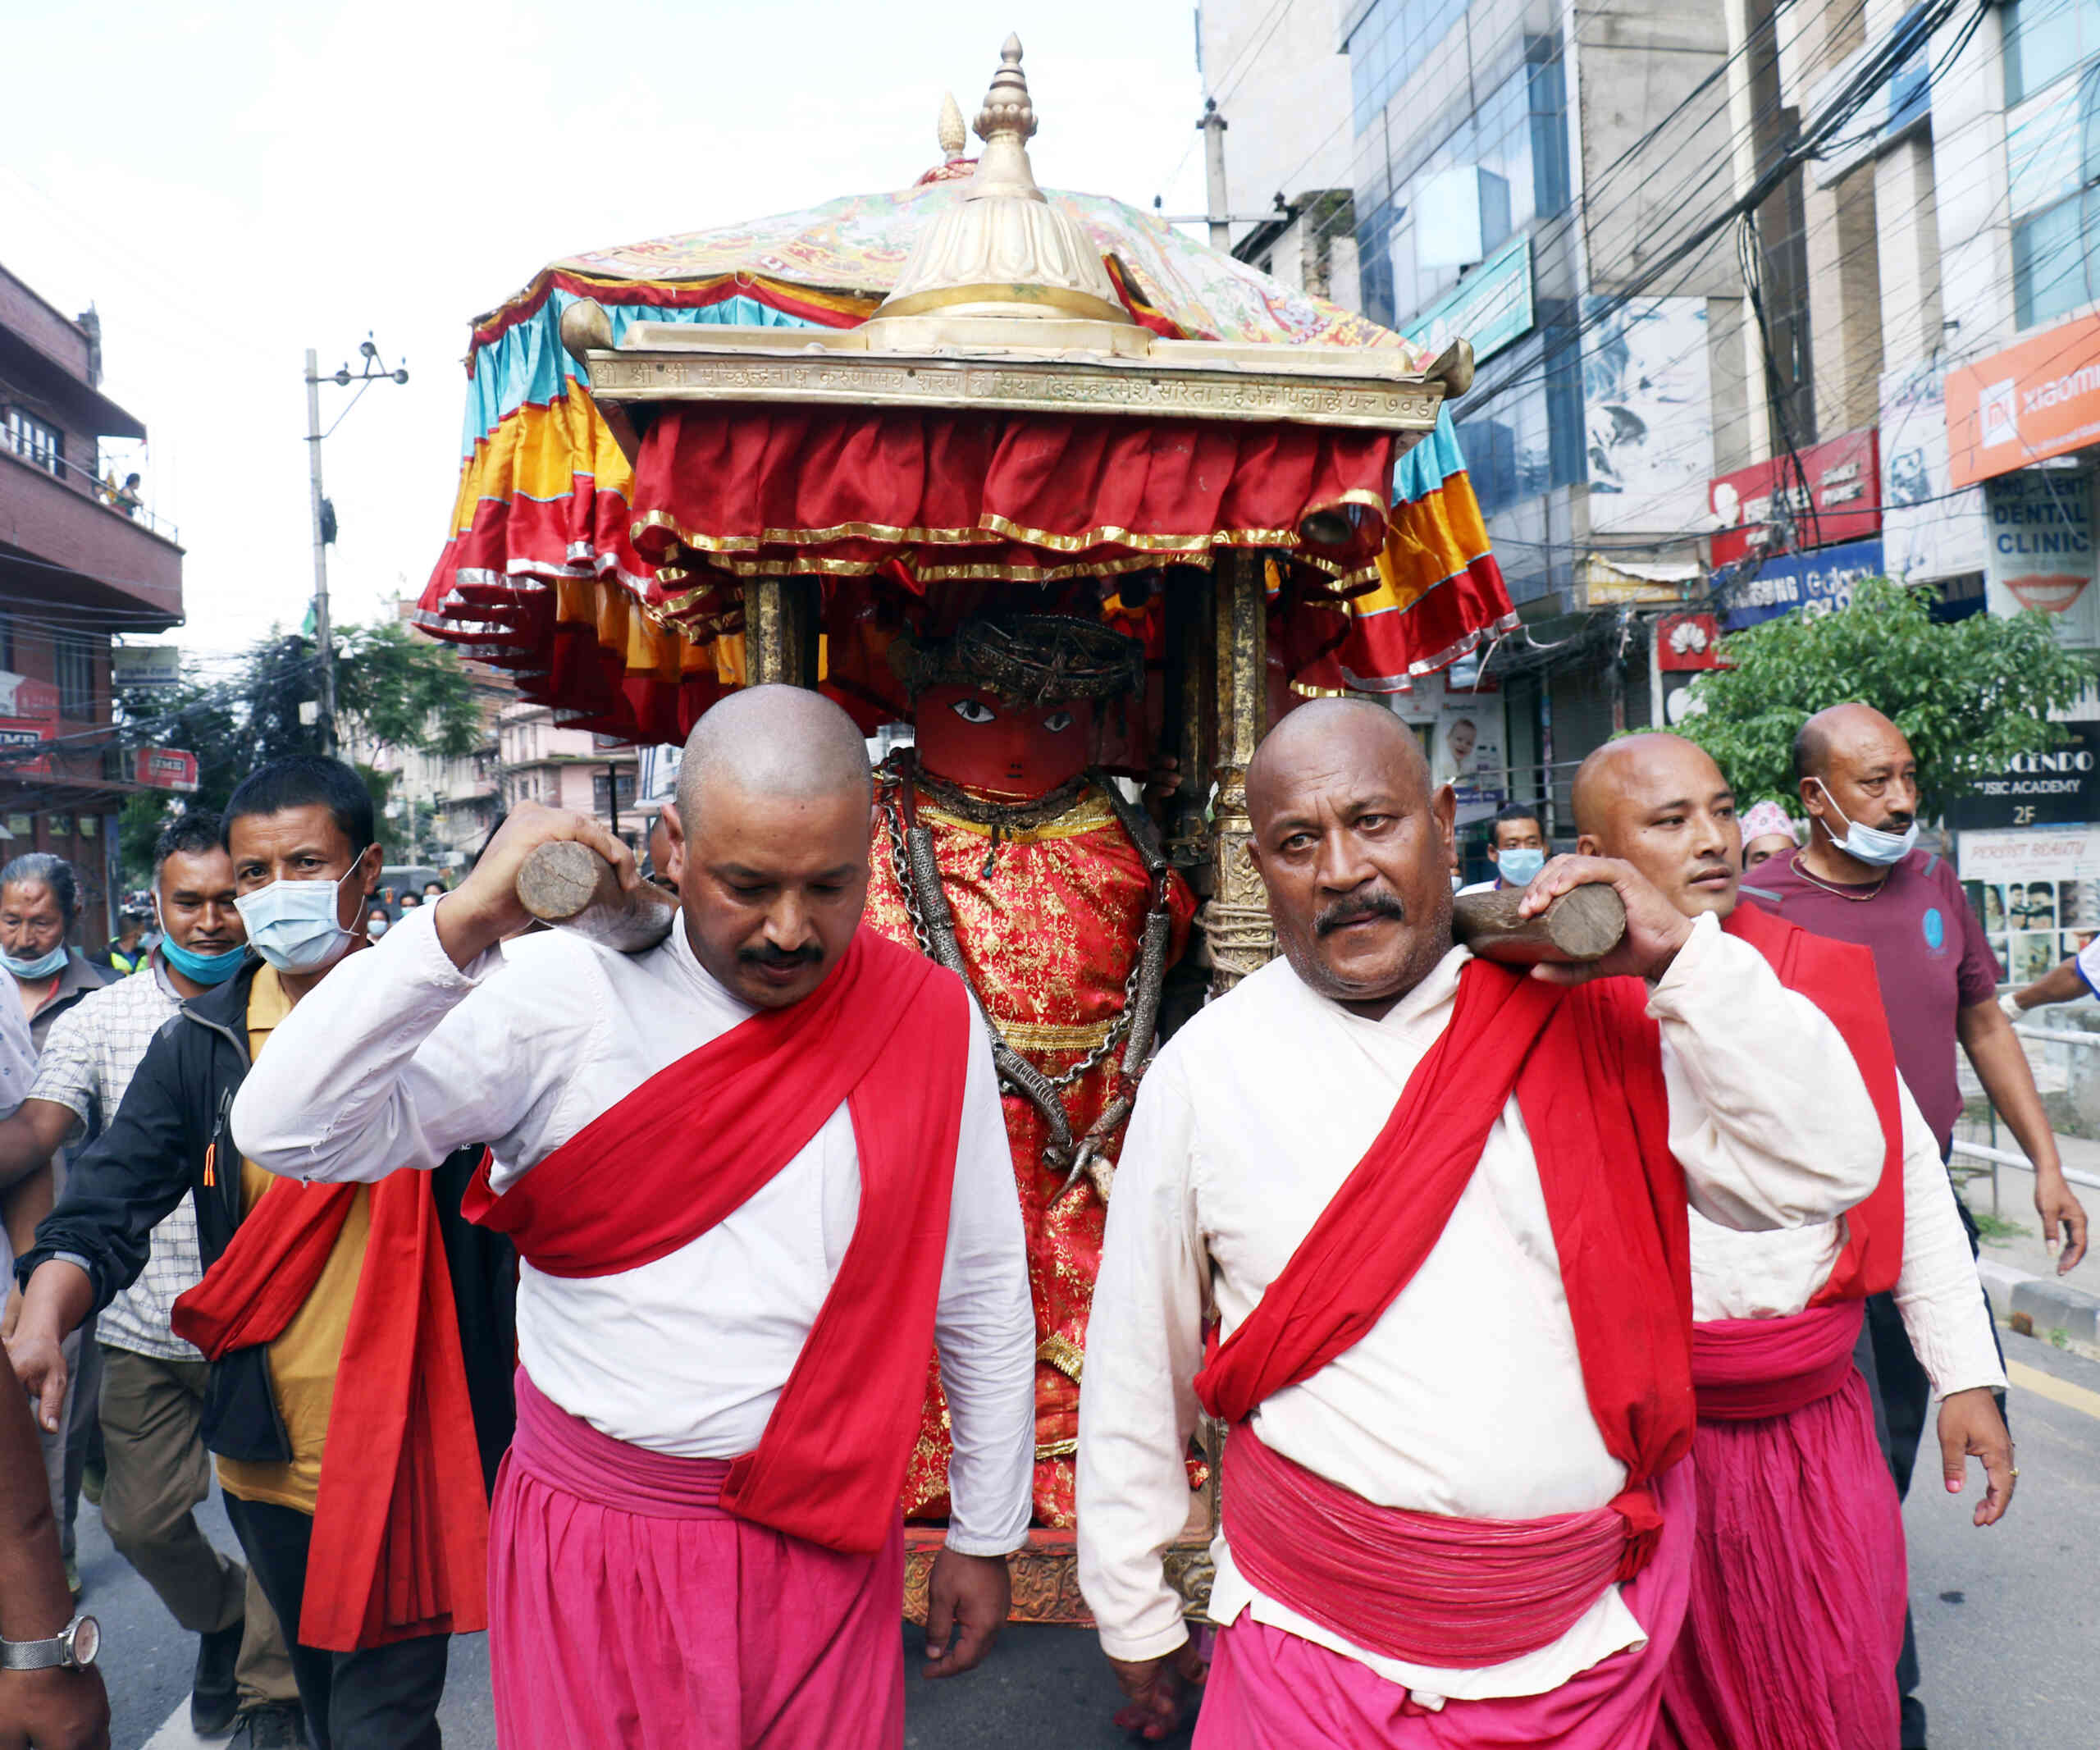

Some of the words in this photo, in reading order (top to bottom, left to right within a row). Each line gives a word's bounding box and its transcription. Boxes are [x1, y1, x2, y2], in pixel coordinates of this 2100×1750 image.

[1993, 503, 2088, 524] DENTAL
[1997, 532, 2089, 554] CLINIC
[1965, 780, 2010, 795] USIC
[2011, 779, 2081, 795] ACADEMY
[2013, 805, 2035, 825] 2F
